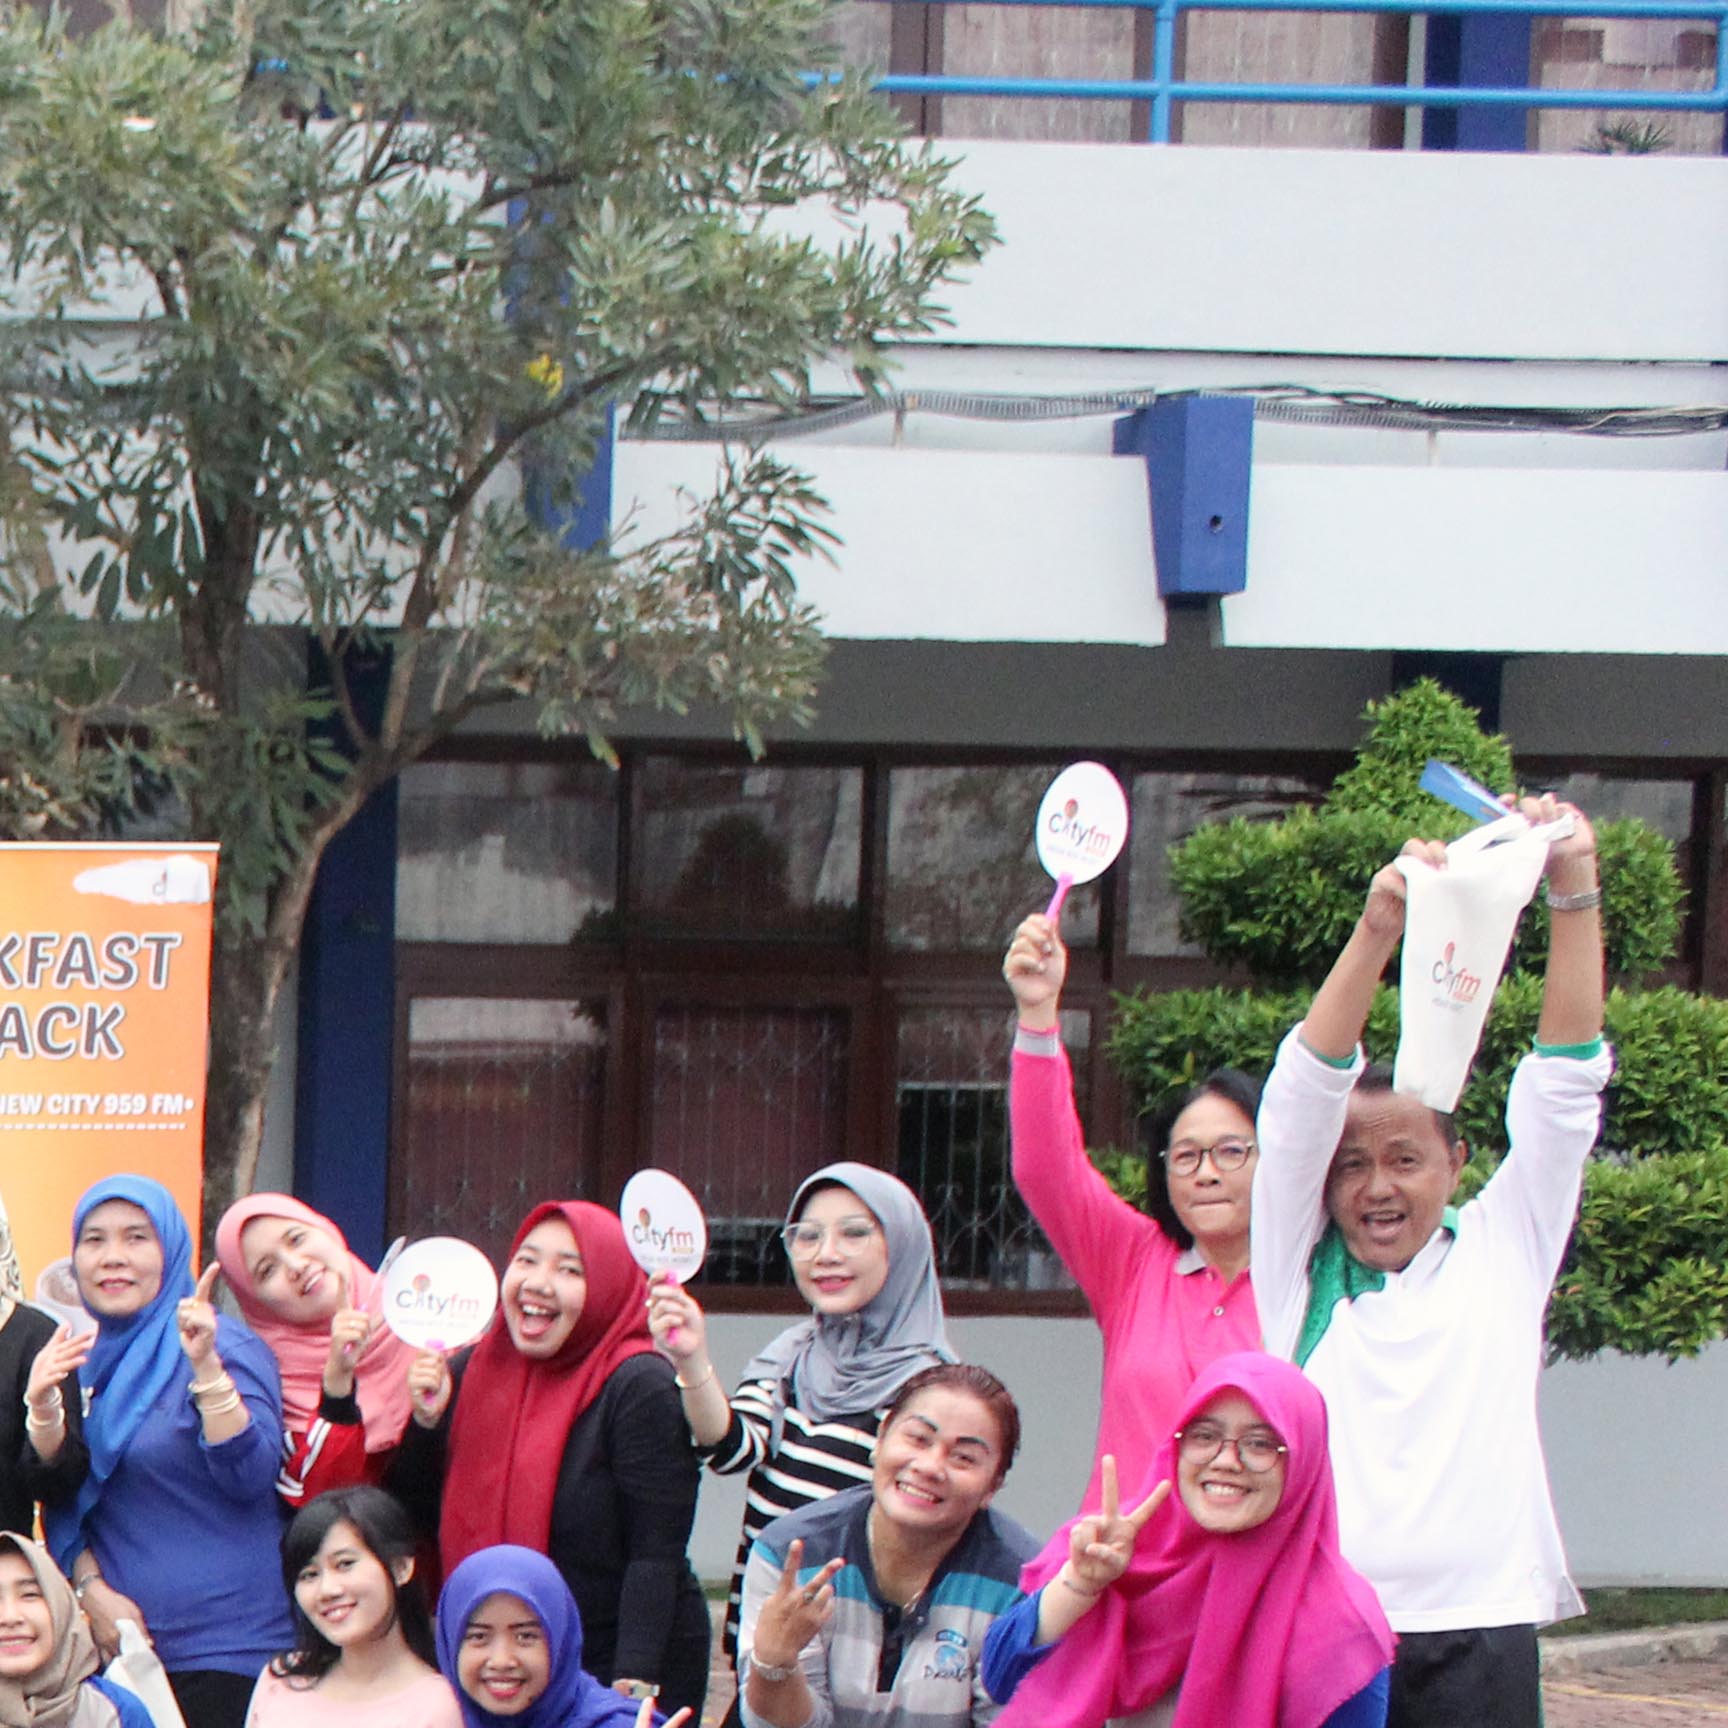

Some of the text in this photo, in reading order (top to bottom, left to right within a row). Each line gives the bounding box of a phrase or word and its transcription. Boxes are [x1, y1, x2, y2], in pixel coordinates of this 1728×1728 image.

[47, 1094, 100, 1115] CITY
[104, 1093, 147, 1115] 959
[396, 1274, 479, 1315] Cityfm
